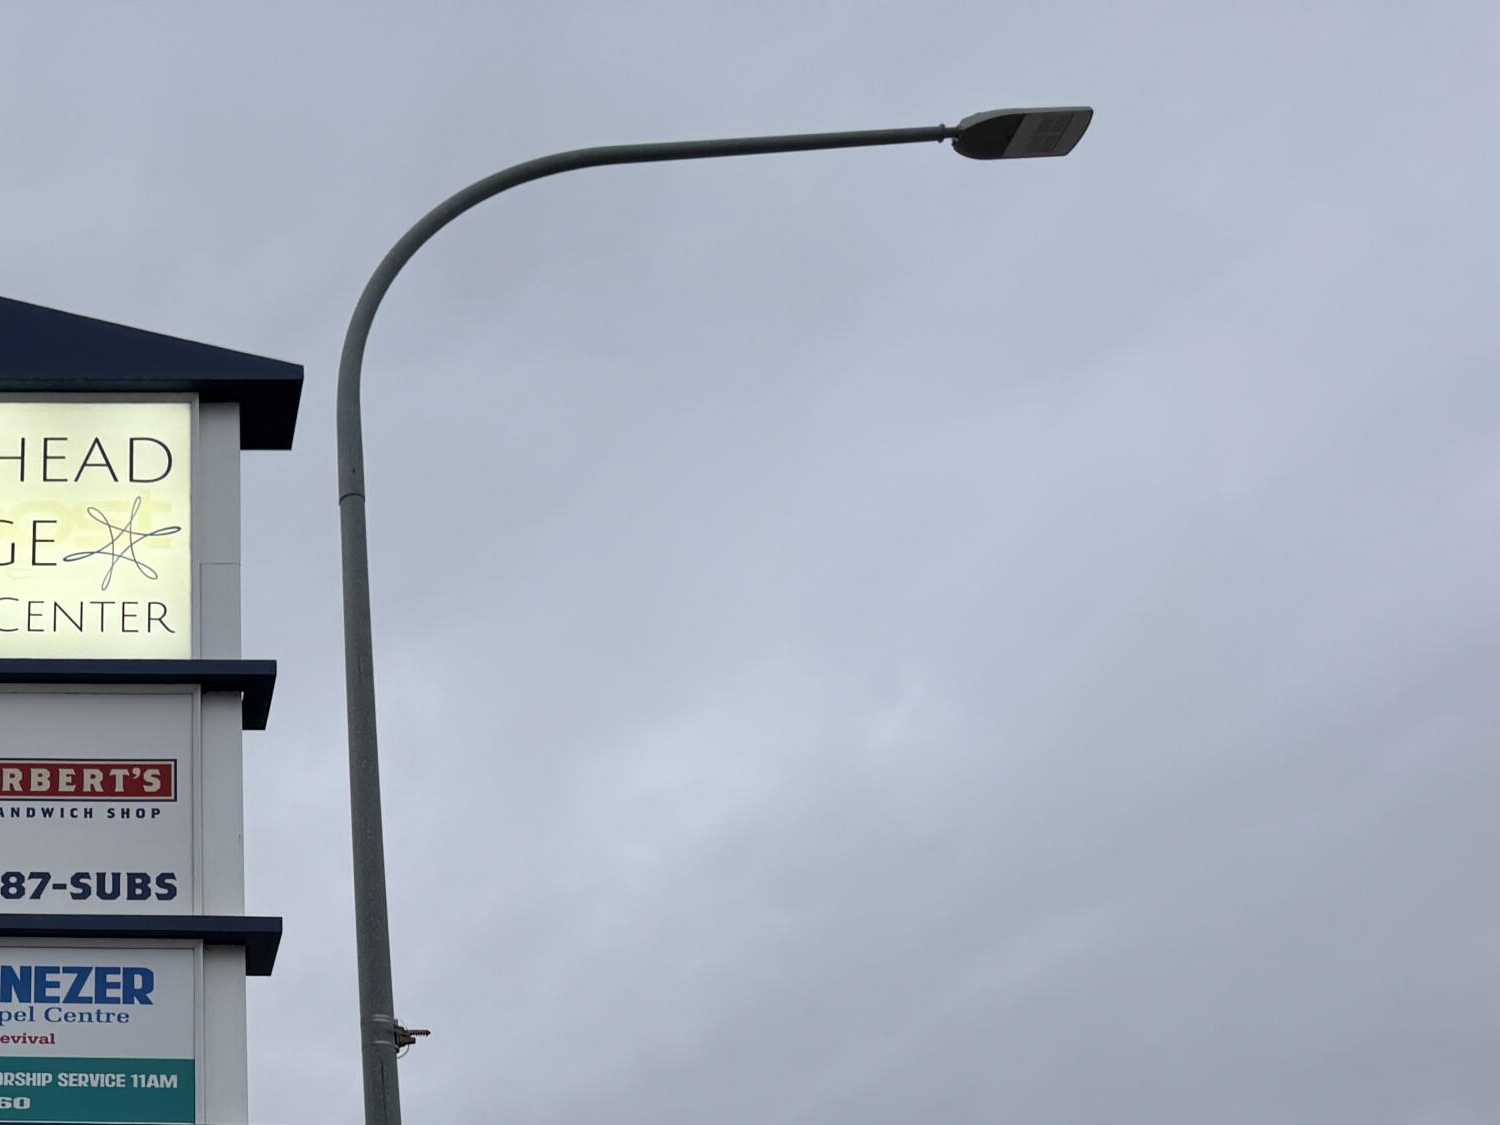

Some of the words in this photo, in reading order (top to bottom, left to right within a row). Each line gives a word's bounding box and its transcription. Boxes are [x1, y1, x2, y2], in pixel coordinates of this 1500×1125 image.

[107, 807, 161, 820] SHOP
[43, 1006, 130, 1024] Centre
[58, 1072, 126, 1089] SERVICE
[130, 1074, 178, 1089] 11AM
